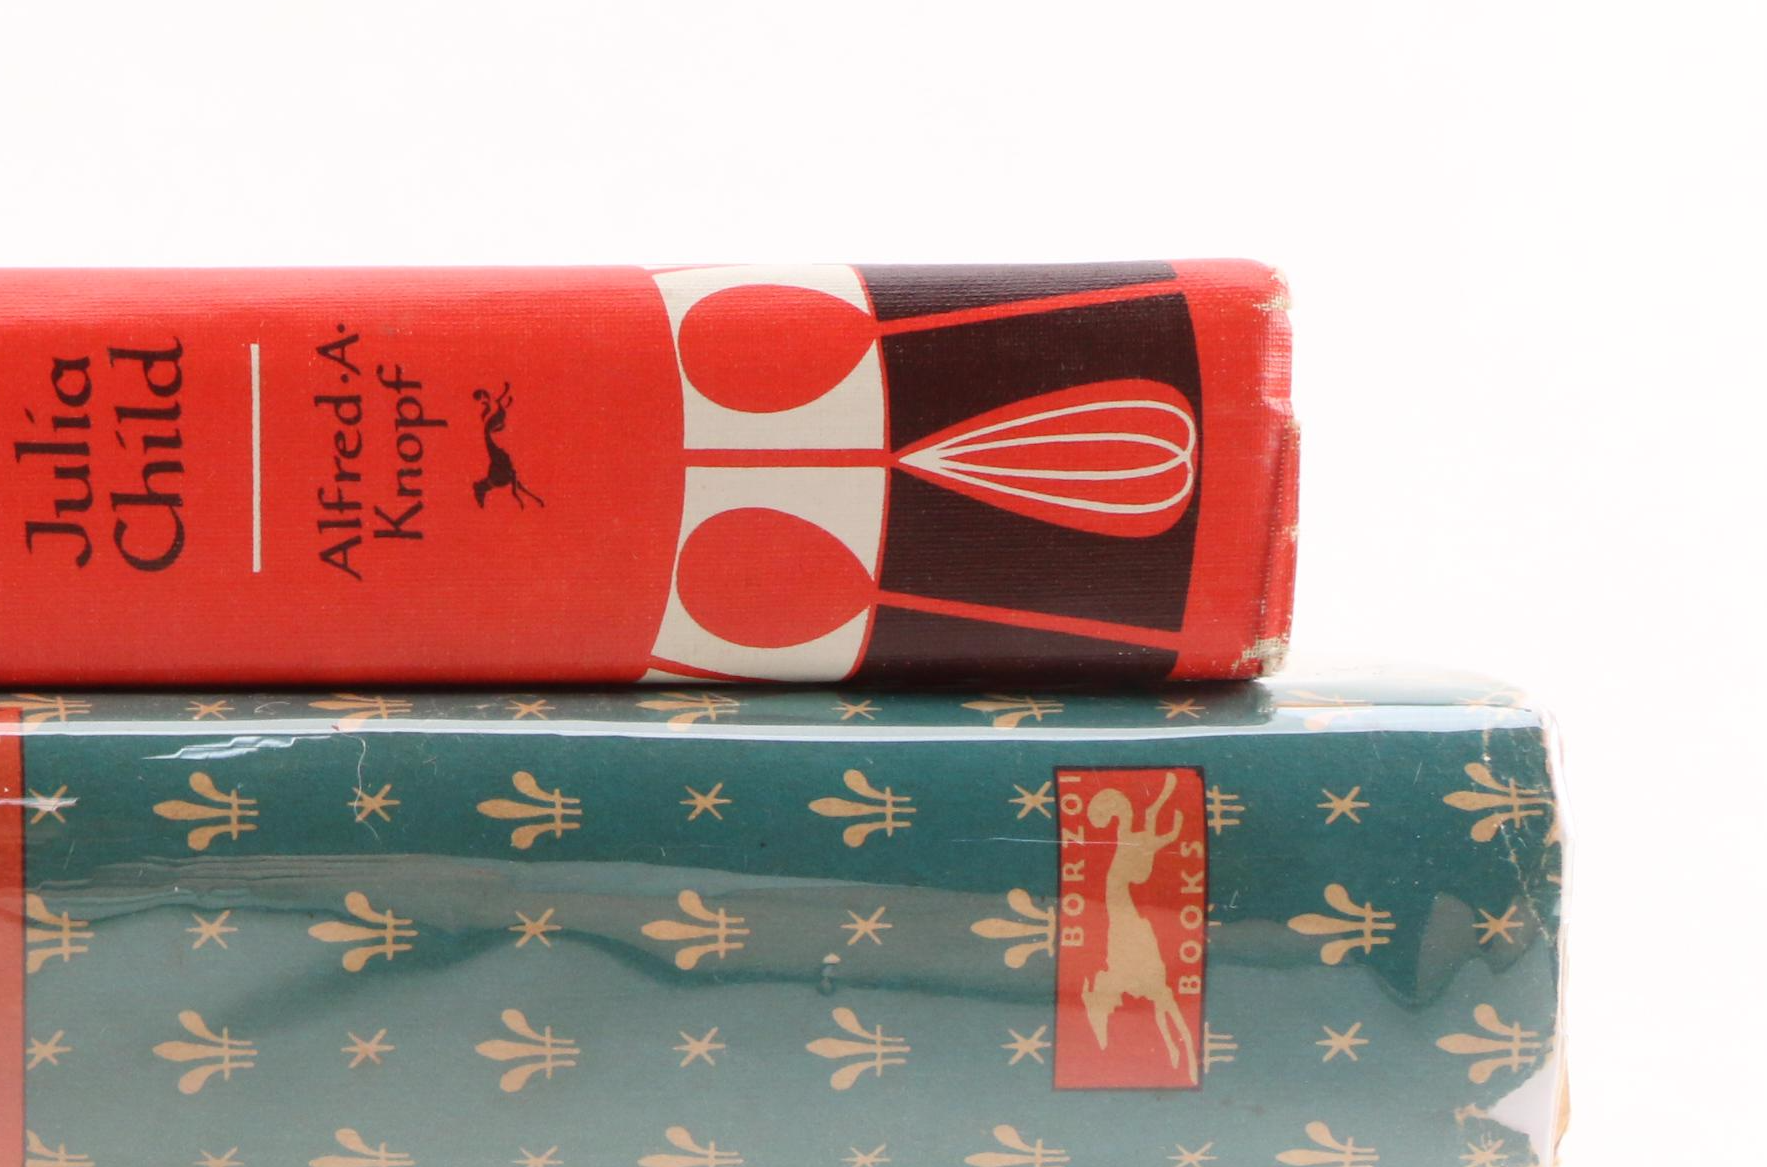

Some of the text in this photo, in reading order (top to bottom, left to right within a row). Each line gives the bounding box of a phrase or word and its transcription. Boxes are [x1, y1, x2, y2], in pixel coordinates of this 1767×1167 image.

[15, 355, 92, 569] Julia
[107, 335, 186, 574] Child
[314, 394, 363, 581] Alfred
[373, 363, 449, 540] Knopf
[1058, 774, 1085, 948] BORZOI
[1177, 839, 1206, 996] BOOKS
